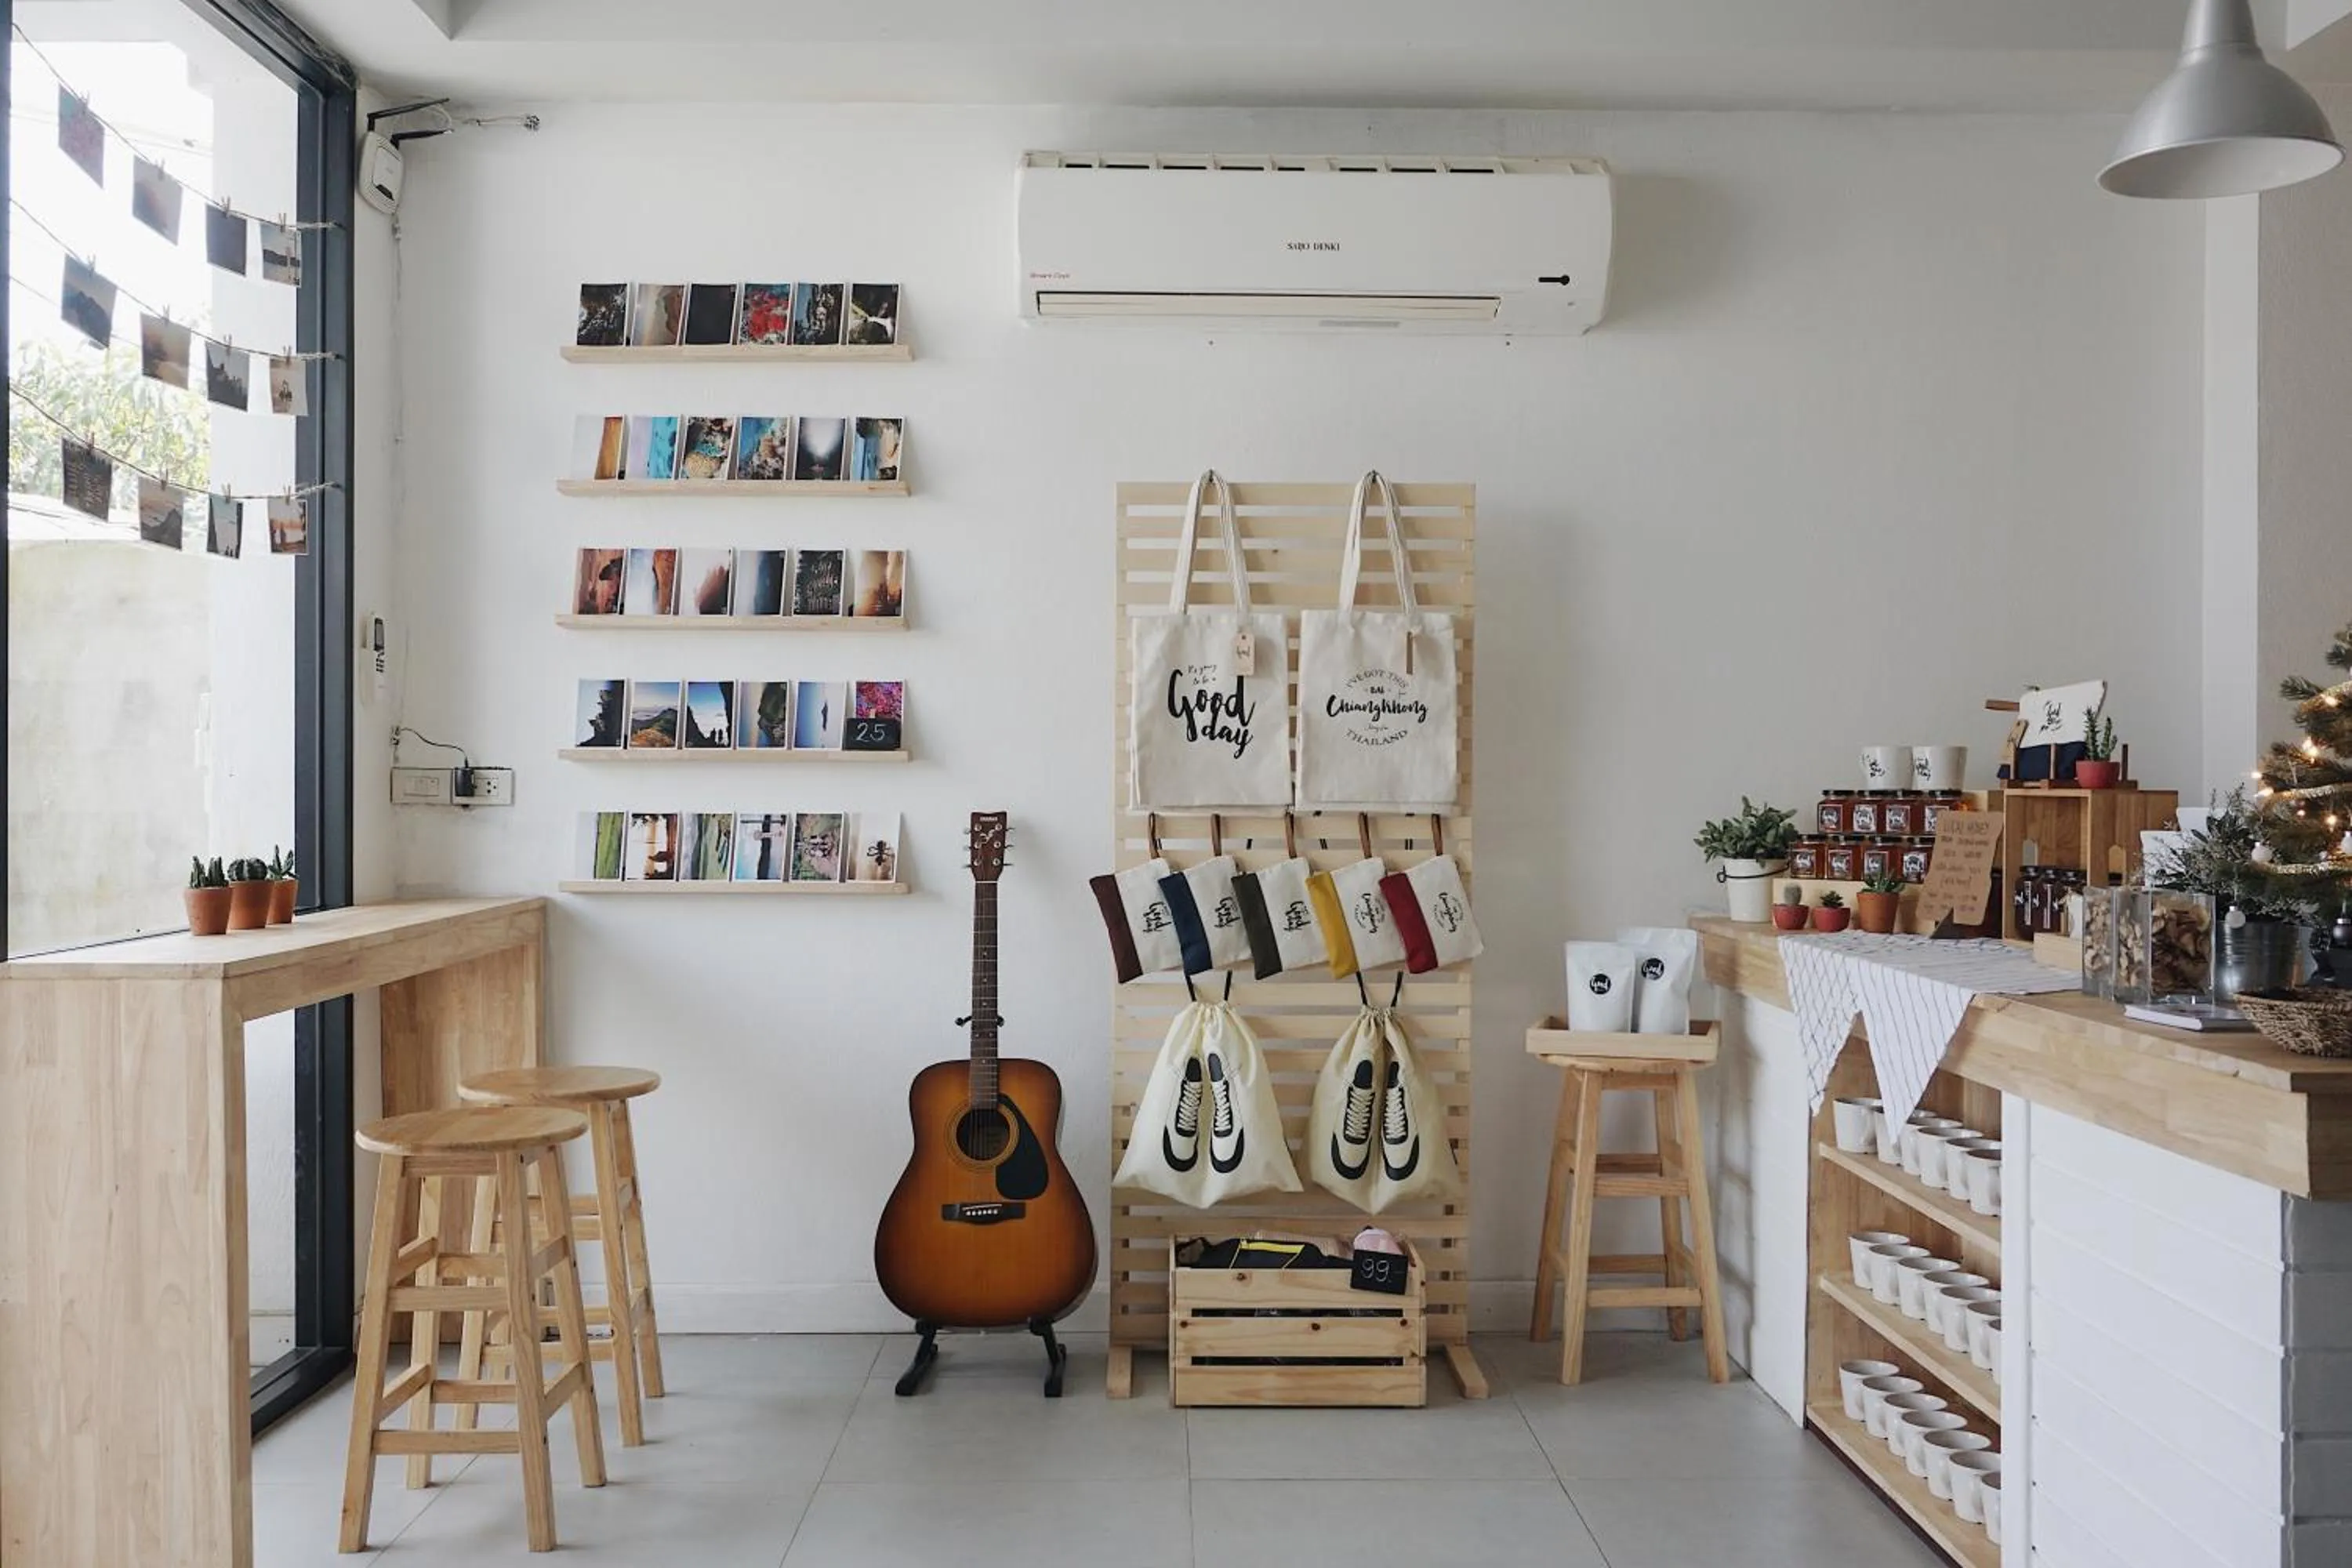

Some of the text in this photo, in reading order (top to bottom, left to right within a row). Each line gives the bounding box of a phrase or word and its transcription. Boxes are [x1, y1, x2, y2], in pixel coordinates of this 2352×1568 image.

[1167, 669, 1256, 742] Good
[855, 722, 887, 742] 25
[1200, 712, 1254, 759] day
